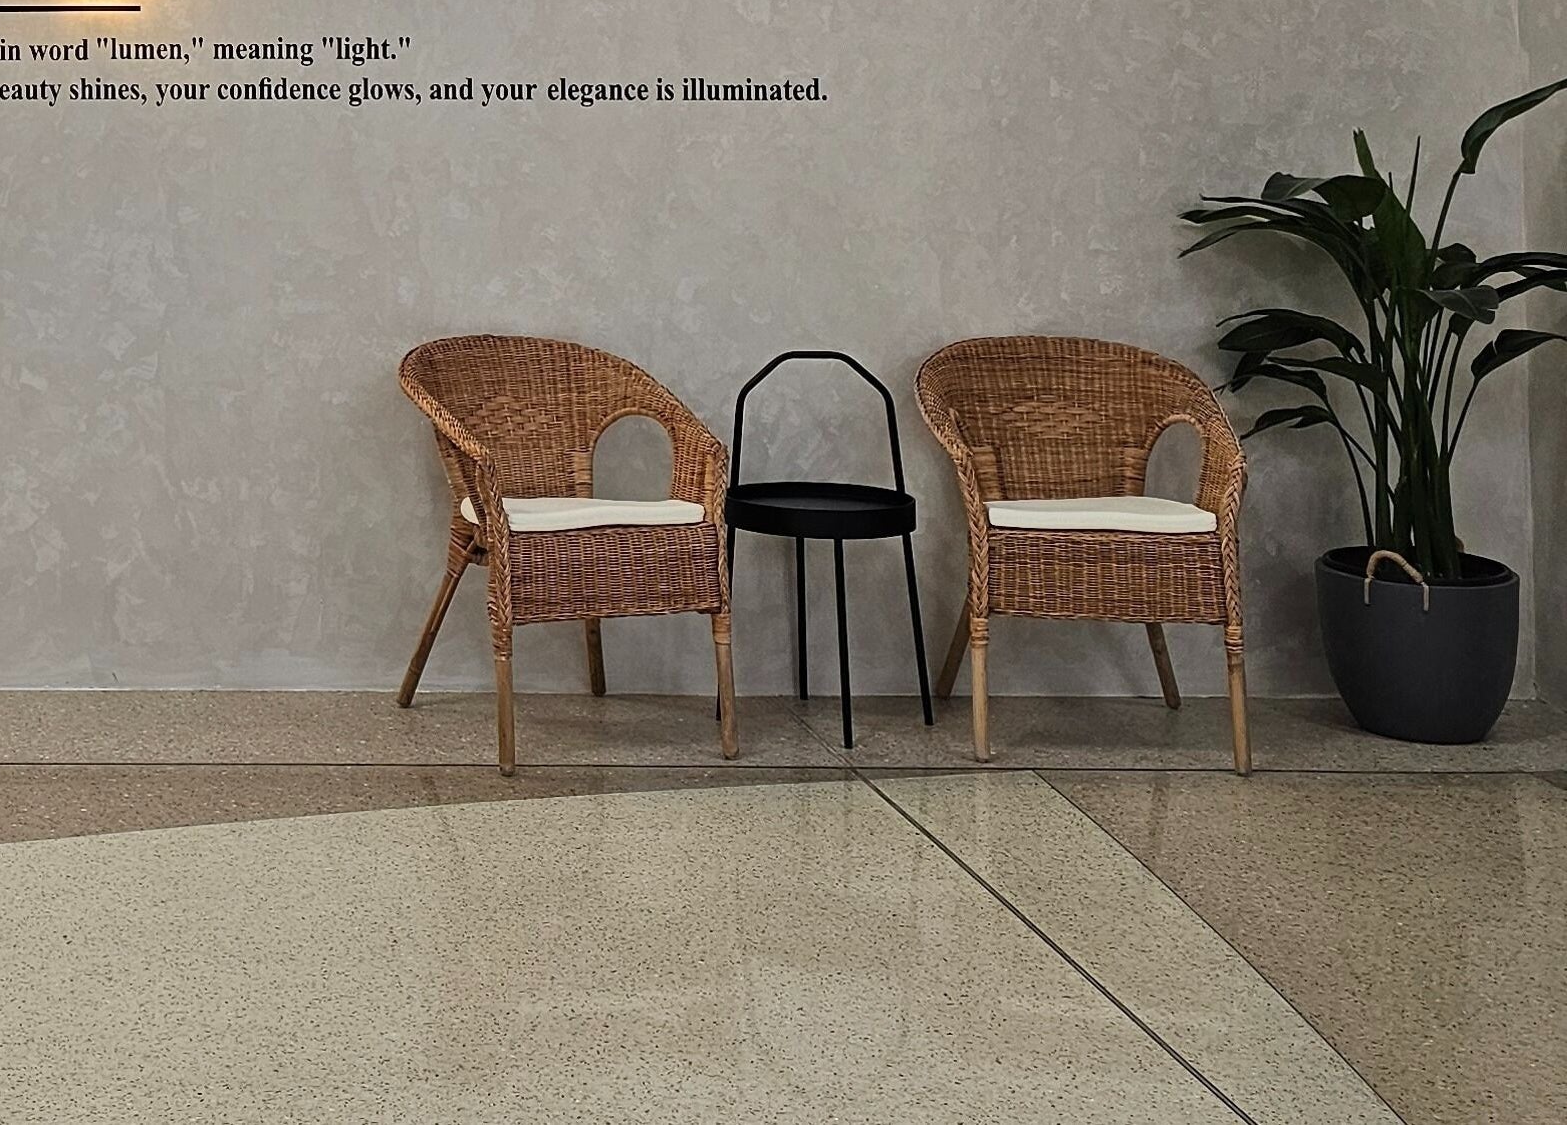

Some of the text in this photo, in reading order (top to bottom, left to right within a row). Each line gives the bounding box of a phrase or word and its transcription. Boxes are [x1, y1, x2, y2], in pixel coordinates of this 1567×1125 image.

[29, 38, 89, 61] word
[96, 36, 204, 65] "lumen,"
[213, 36, 314, 67] meaning
[321, 36, 411, 67] "light."
[69, 77, 148, 106] shines,
[155, 83, 211, 107] your
[217, 76, 341, 100] confidence
[348, 77, 422, 107] glows,
[429, 77, 474, 101] and
[481, 83, 538, 107] your
[547, 77, 649, 108] elegance
[656, 77, 675, 101] is
[682, 77, 828, 101] illuminated.
